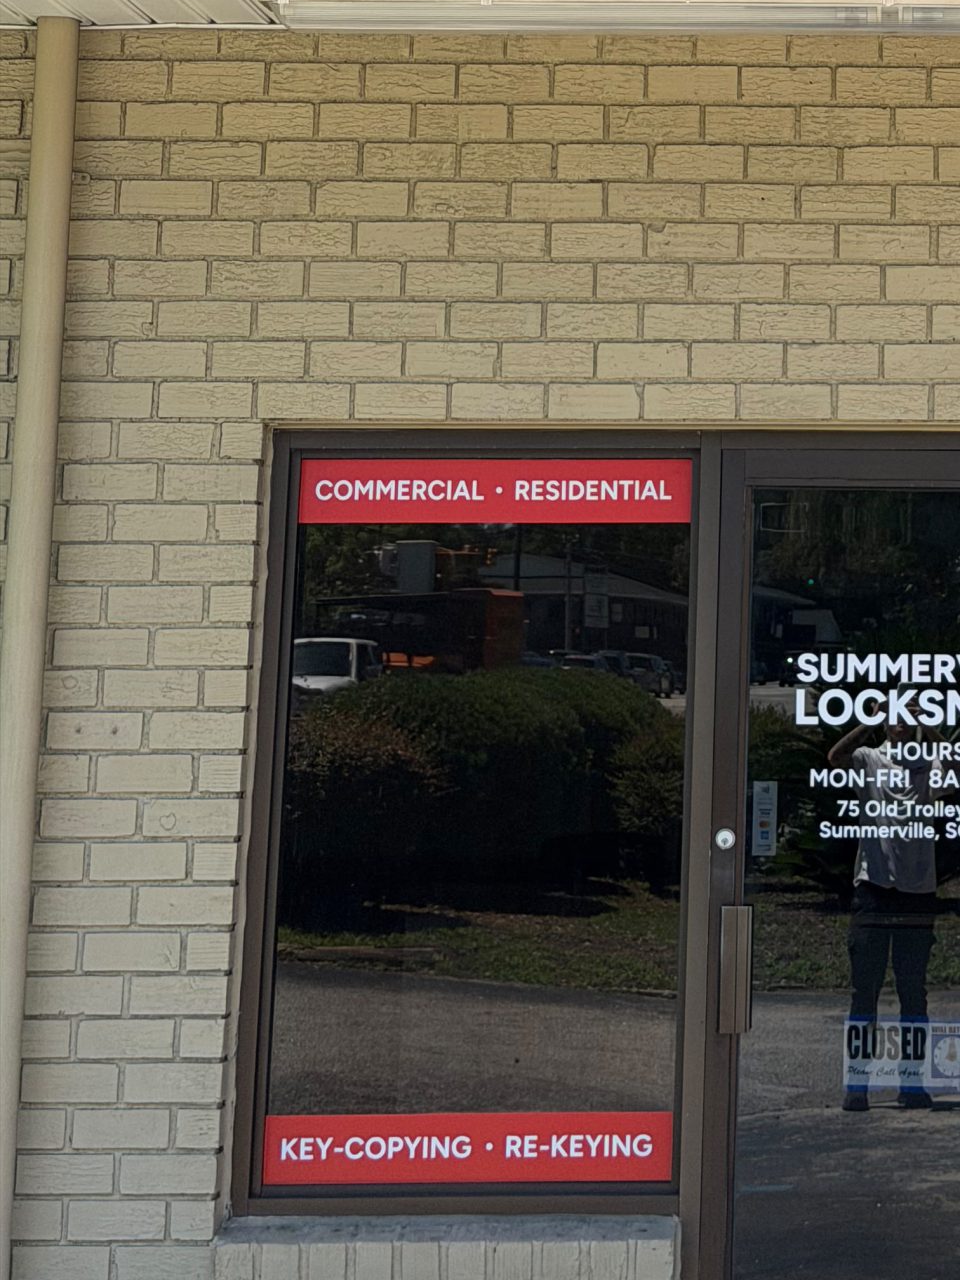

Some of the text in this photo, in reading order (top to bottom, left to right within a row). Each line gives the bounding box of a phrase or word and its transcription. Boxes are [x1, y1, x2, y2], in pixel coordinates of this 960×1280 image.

[315, 479, 672, 501] COMMERCIAL RESIDENTIAL
[809, 768, 910, 788] MON-FRI
[837, 800, 860, 817] 75
[865, 799, 898, 818] Old
[819, 821, 940, 841] Summerville,
[847, 1025, 926, 1061] CLOSED
[280, 1133, 653, 1161] KEY-COPYING RE-KEYING
